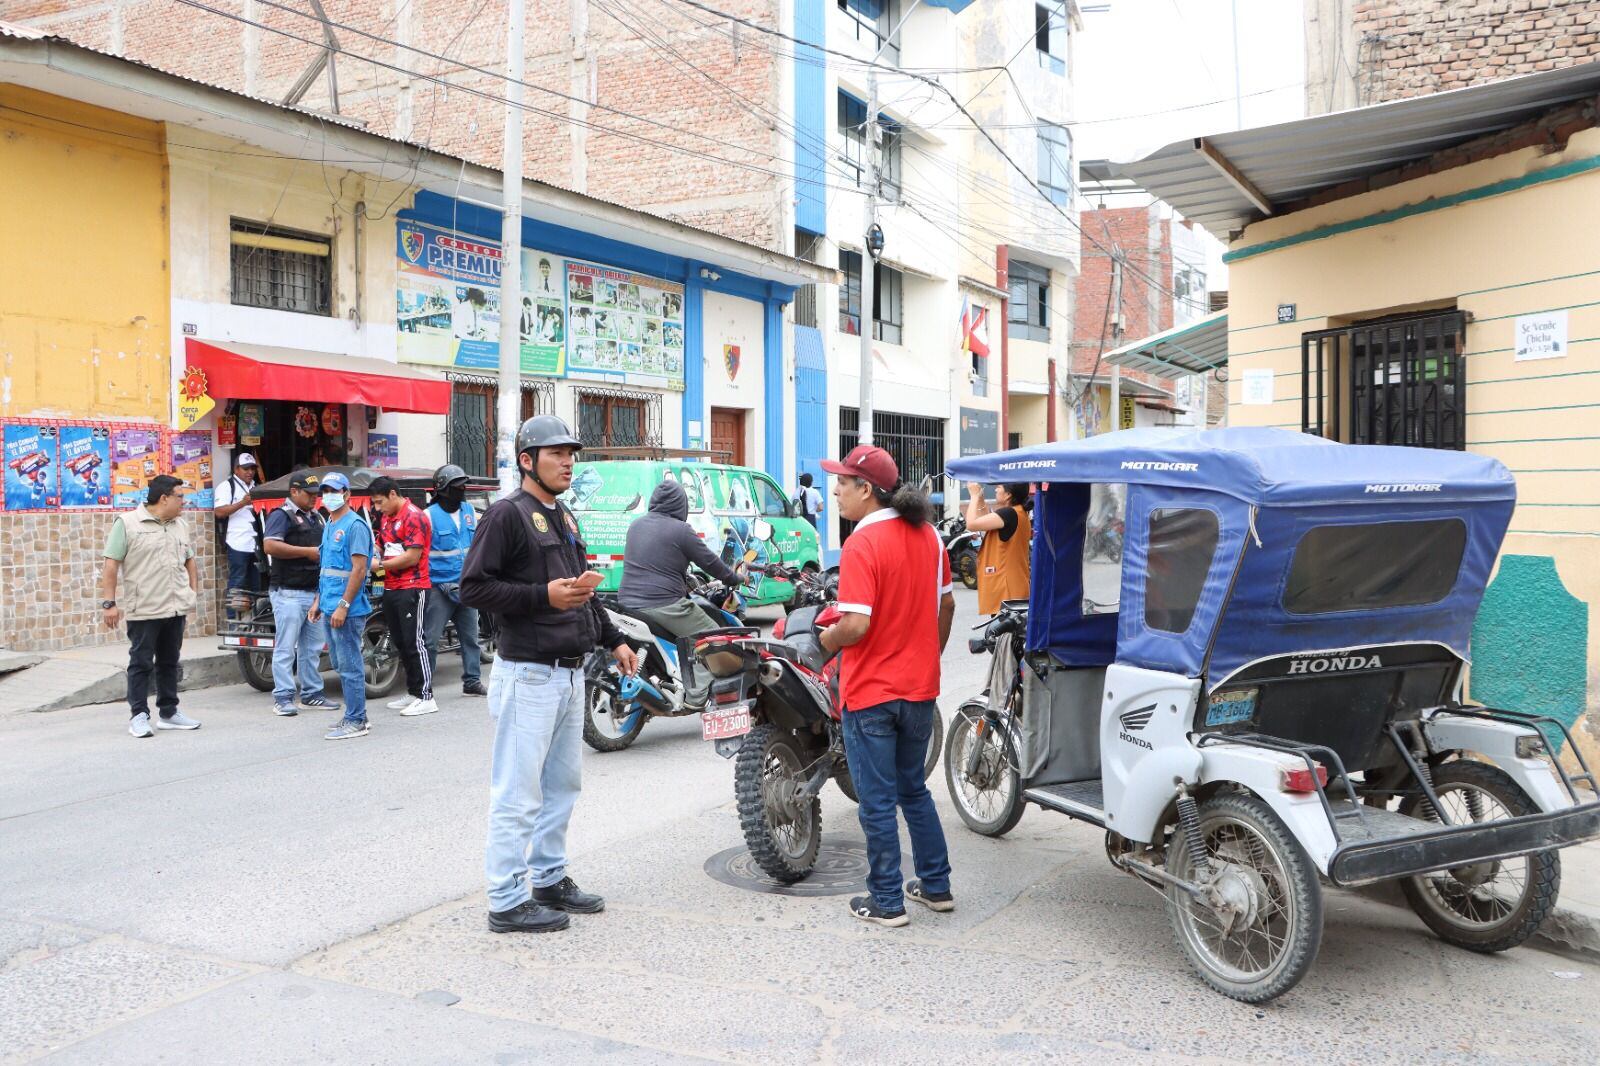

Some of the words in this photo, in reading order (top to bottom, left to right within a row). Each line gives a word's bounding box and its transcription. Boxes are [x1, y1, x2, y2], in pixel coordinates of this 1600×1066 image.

[438, 237, 500, 257] COLEGI
[428, 244, 502, 278] PREMIU
[1521, 323, 1530, 334] Se
[999, 460, 1057, 470] MOTOKAR
[1120, 461, 1199, 472] MOTOKAR
[1365, 483, 1442, 493] MOTOKAR
[1287, 654, 1383, 675] HONDA
[705, 714, 748, 735] EU-2300
[1119, 731, 1153, 750] HONDA
